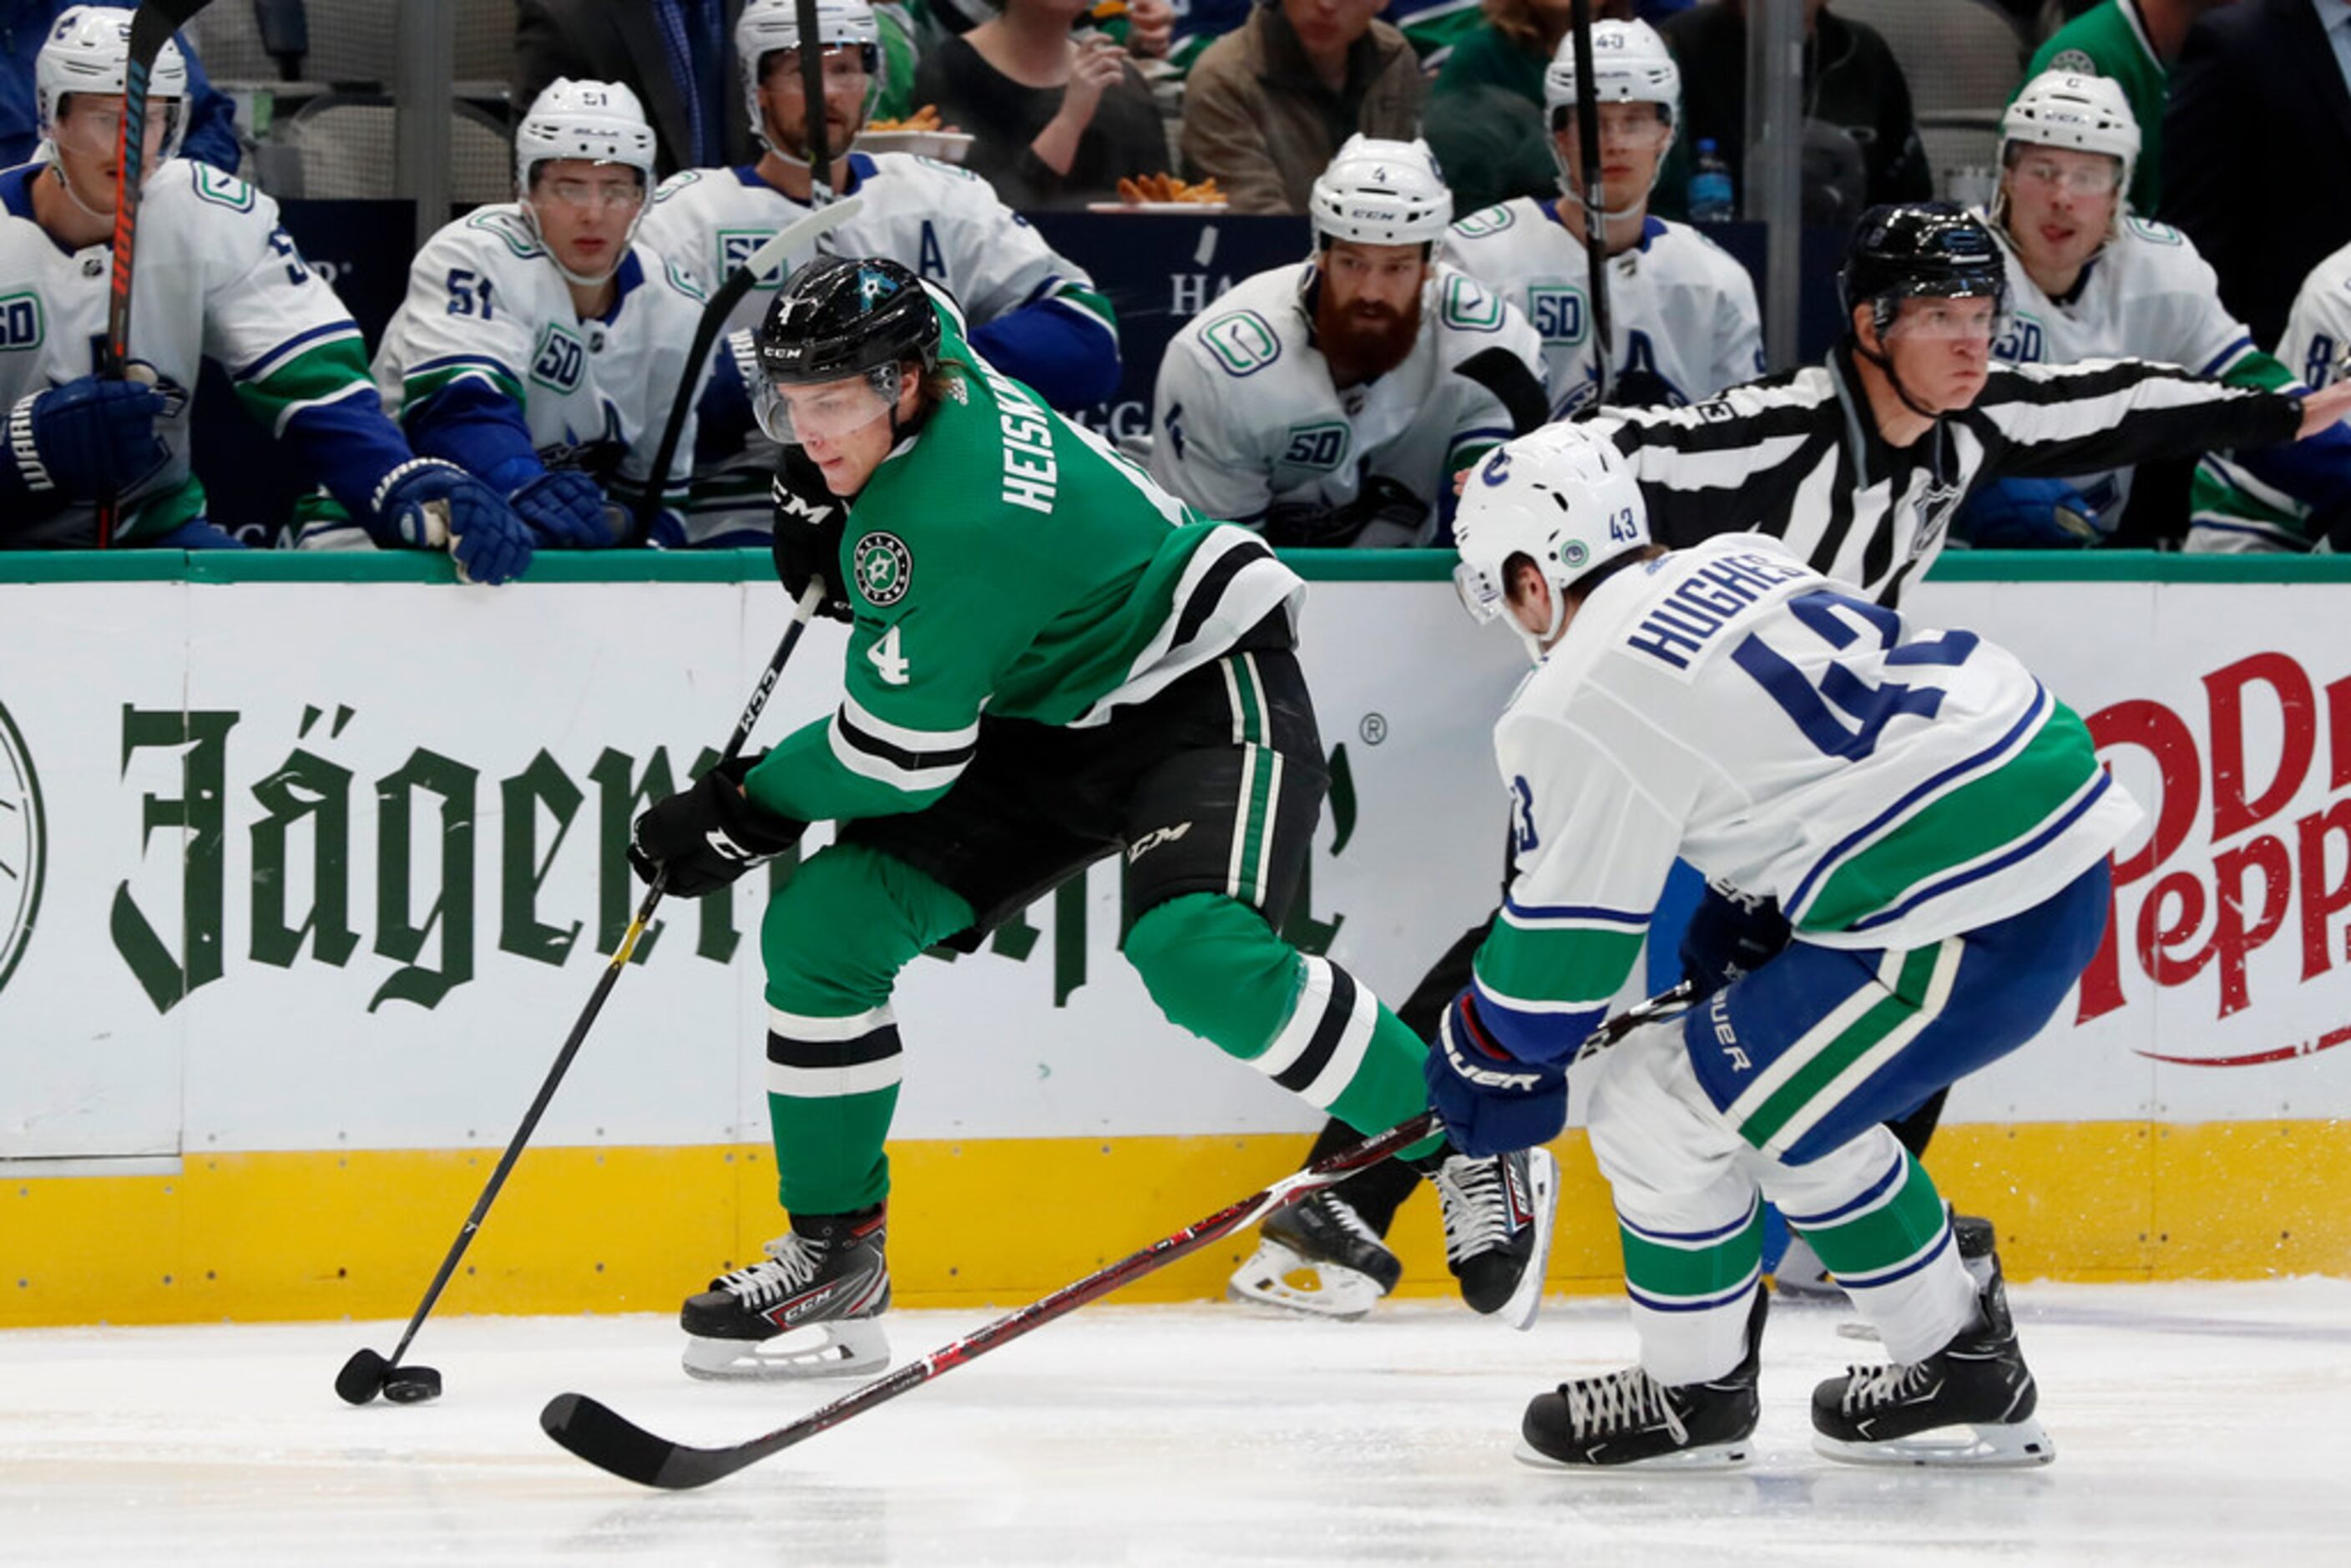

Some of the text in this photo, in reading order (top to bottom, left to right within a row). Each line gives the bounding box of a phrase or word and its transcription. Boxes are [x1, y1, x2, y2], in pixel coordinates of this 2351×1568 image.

[918, 220, 948, 279] A
[446, 267, 493, 321] 51
[763, 346, 802, 359] CCM
[9, 387, 55, 492] WARR
[978, 361, 1058, 515] HEISK
[1610, 506, 1638, 543] 43
[867, 625, 910, 685] 4
[1510, 774, 1540, 853] 3
[2074, 699, 2351, 1029] Pepp
[1440, 1002, 1542, 1092] UER
[784, 1290, 832, 1323] CCM
